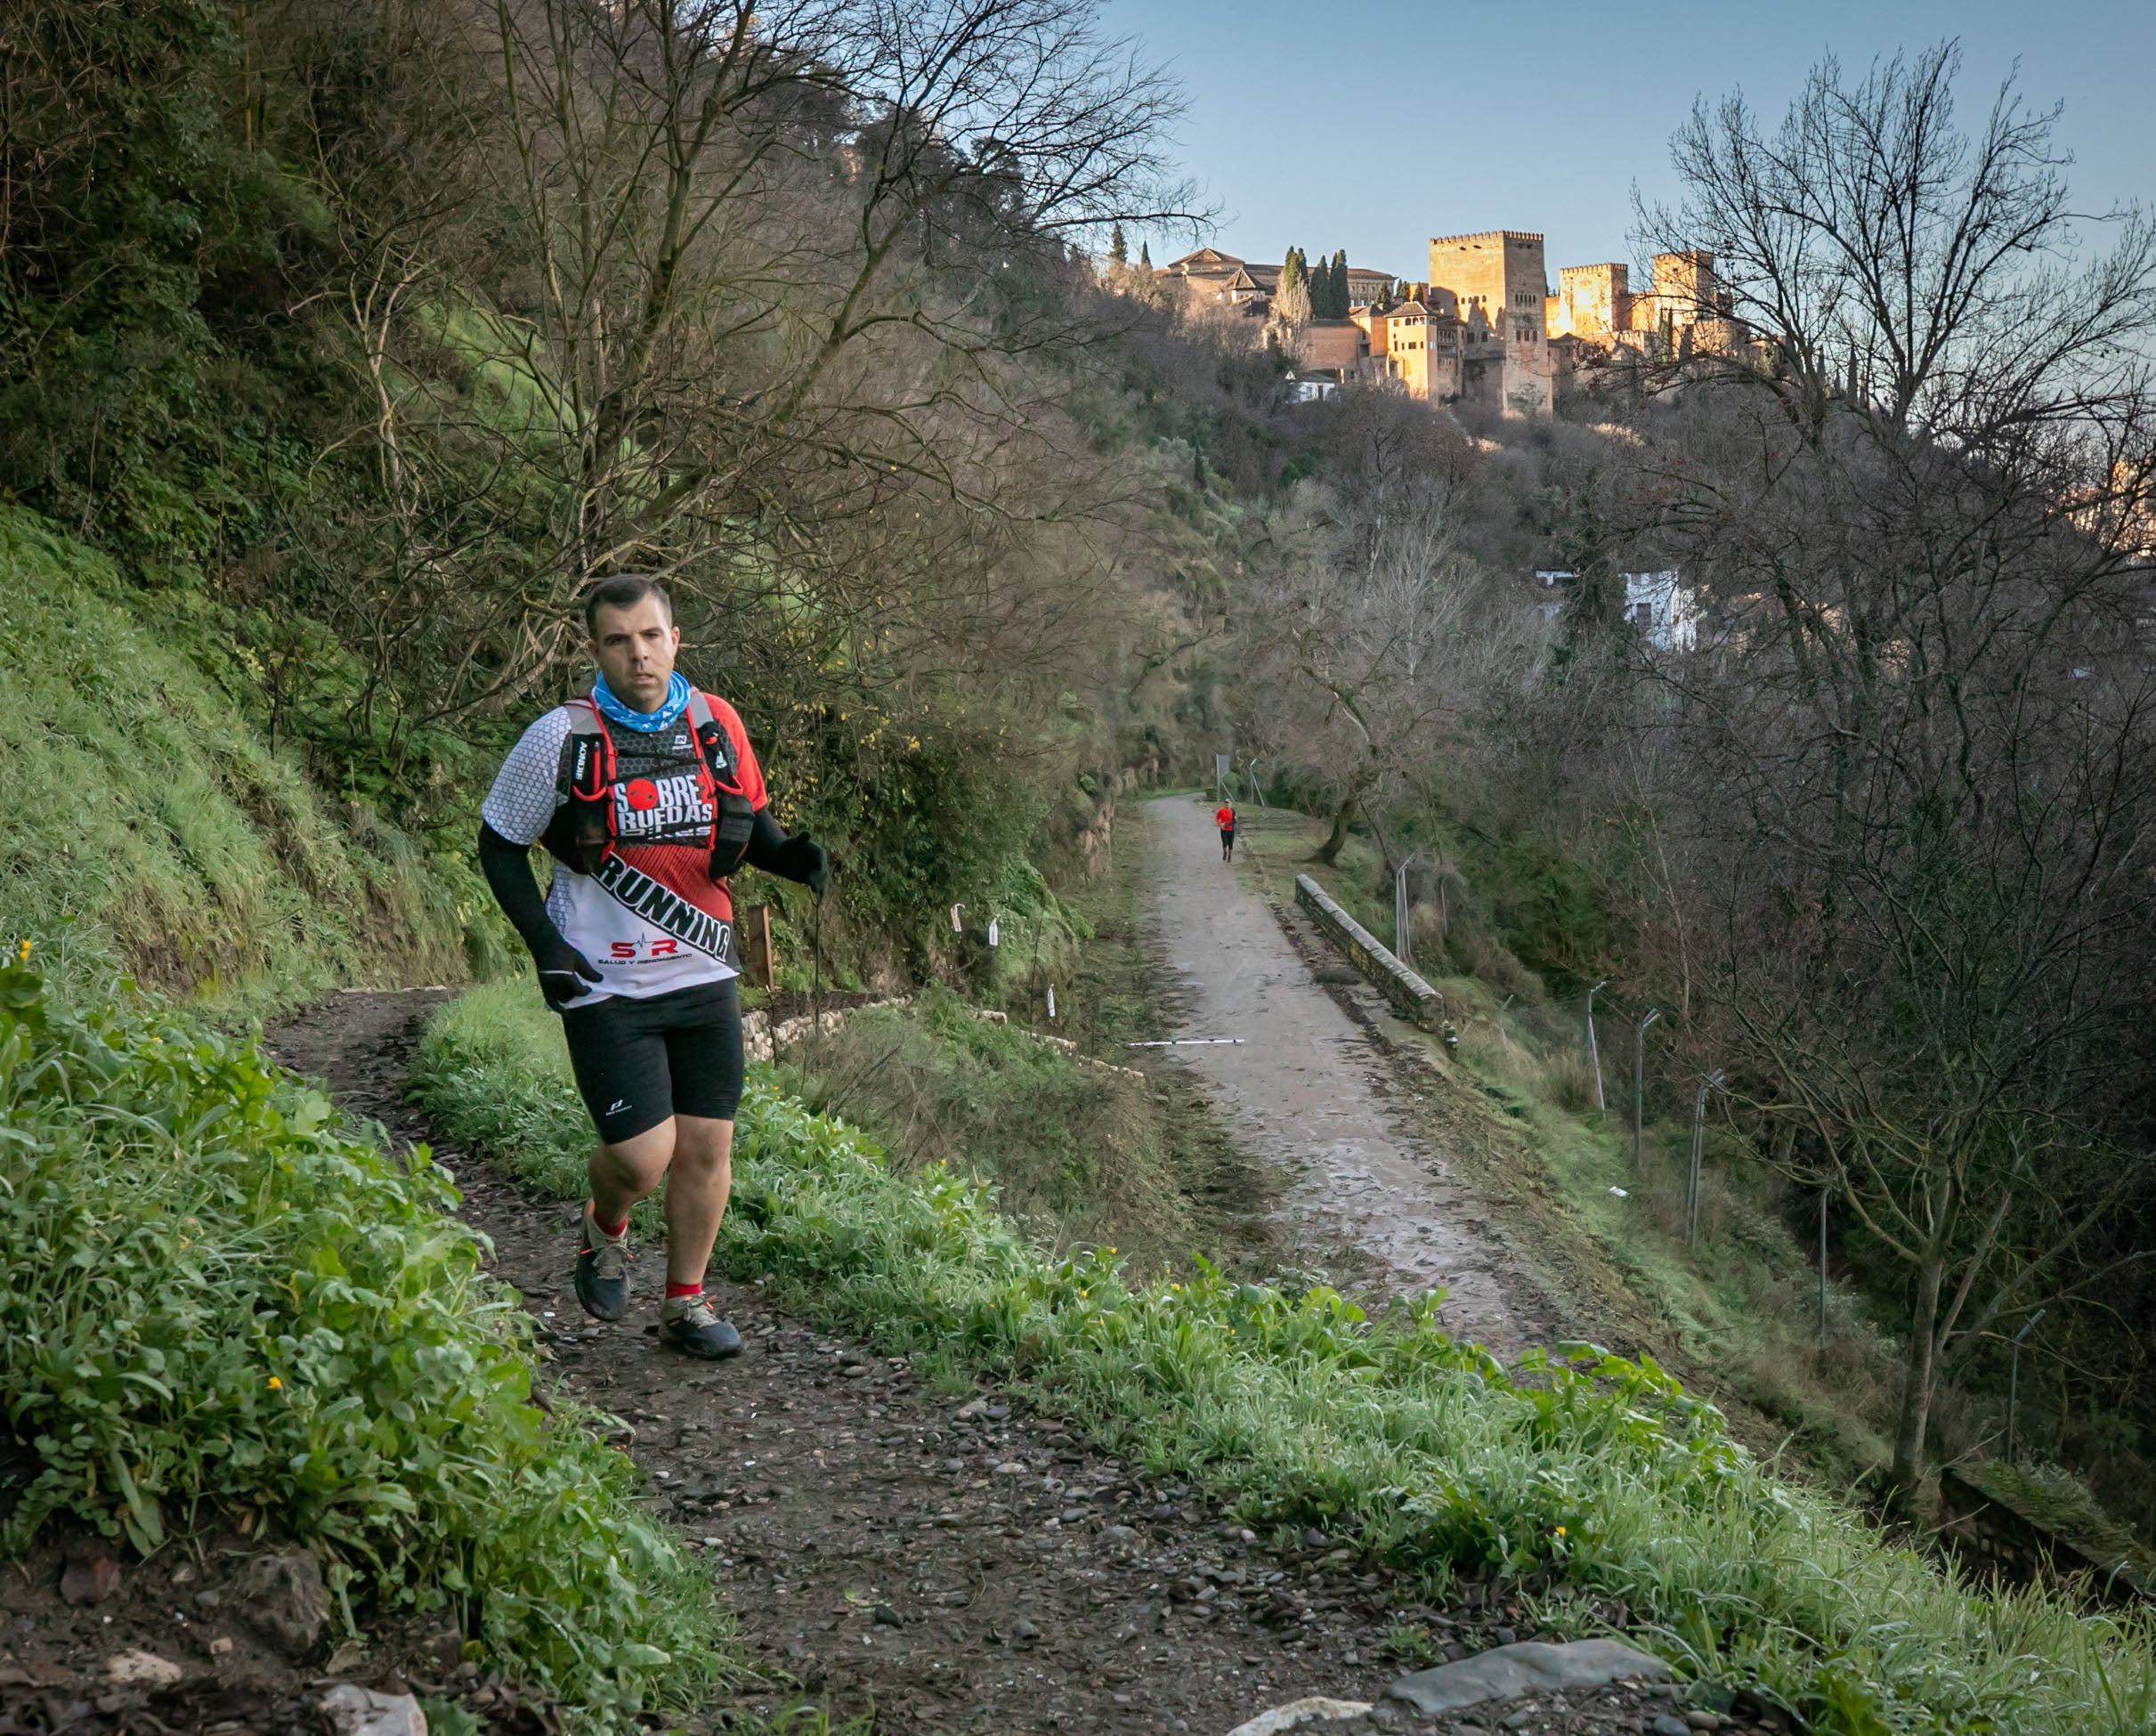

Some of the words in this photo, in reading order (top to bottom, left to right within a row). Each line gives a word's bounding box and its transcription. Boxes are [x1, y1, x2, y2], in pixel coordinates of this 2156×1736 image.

[614, 775, 701, 812] SOBRE
[619, 803, 713, 830] RUEDAS
[597, 851, 730, 963] RUNNING
